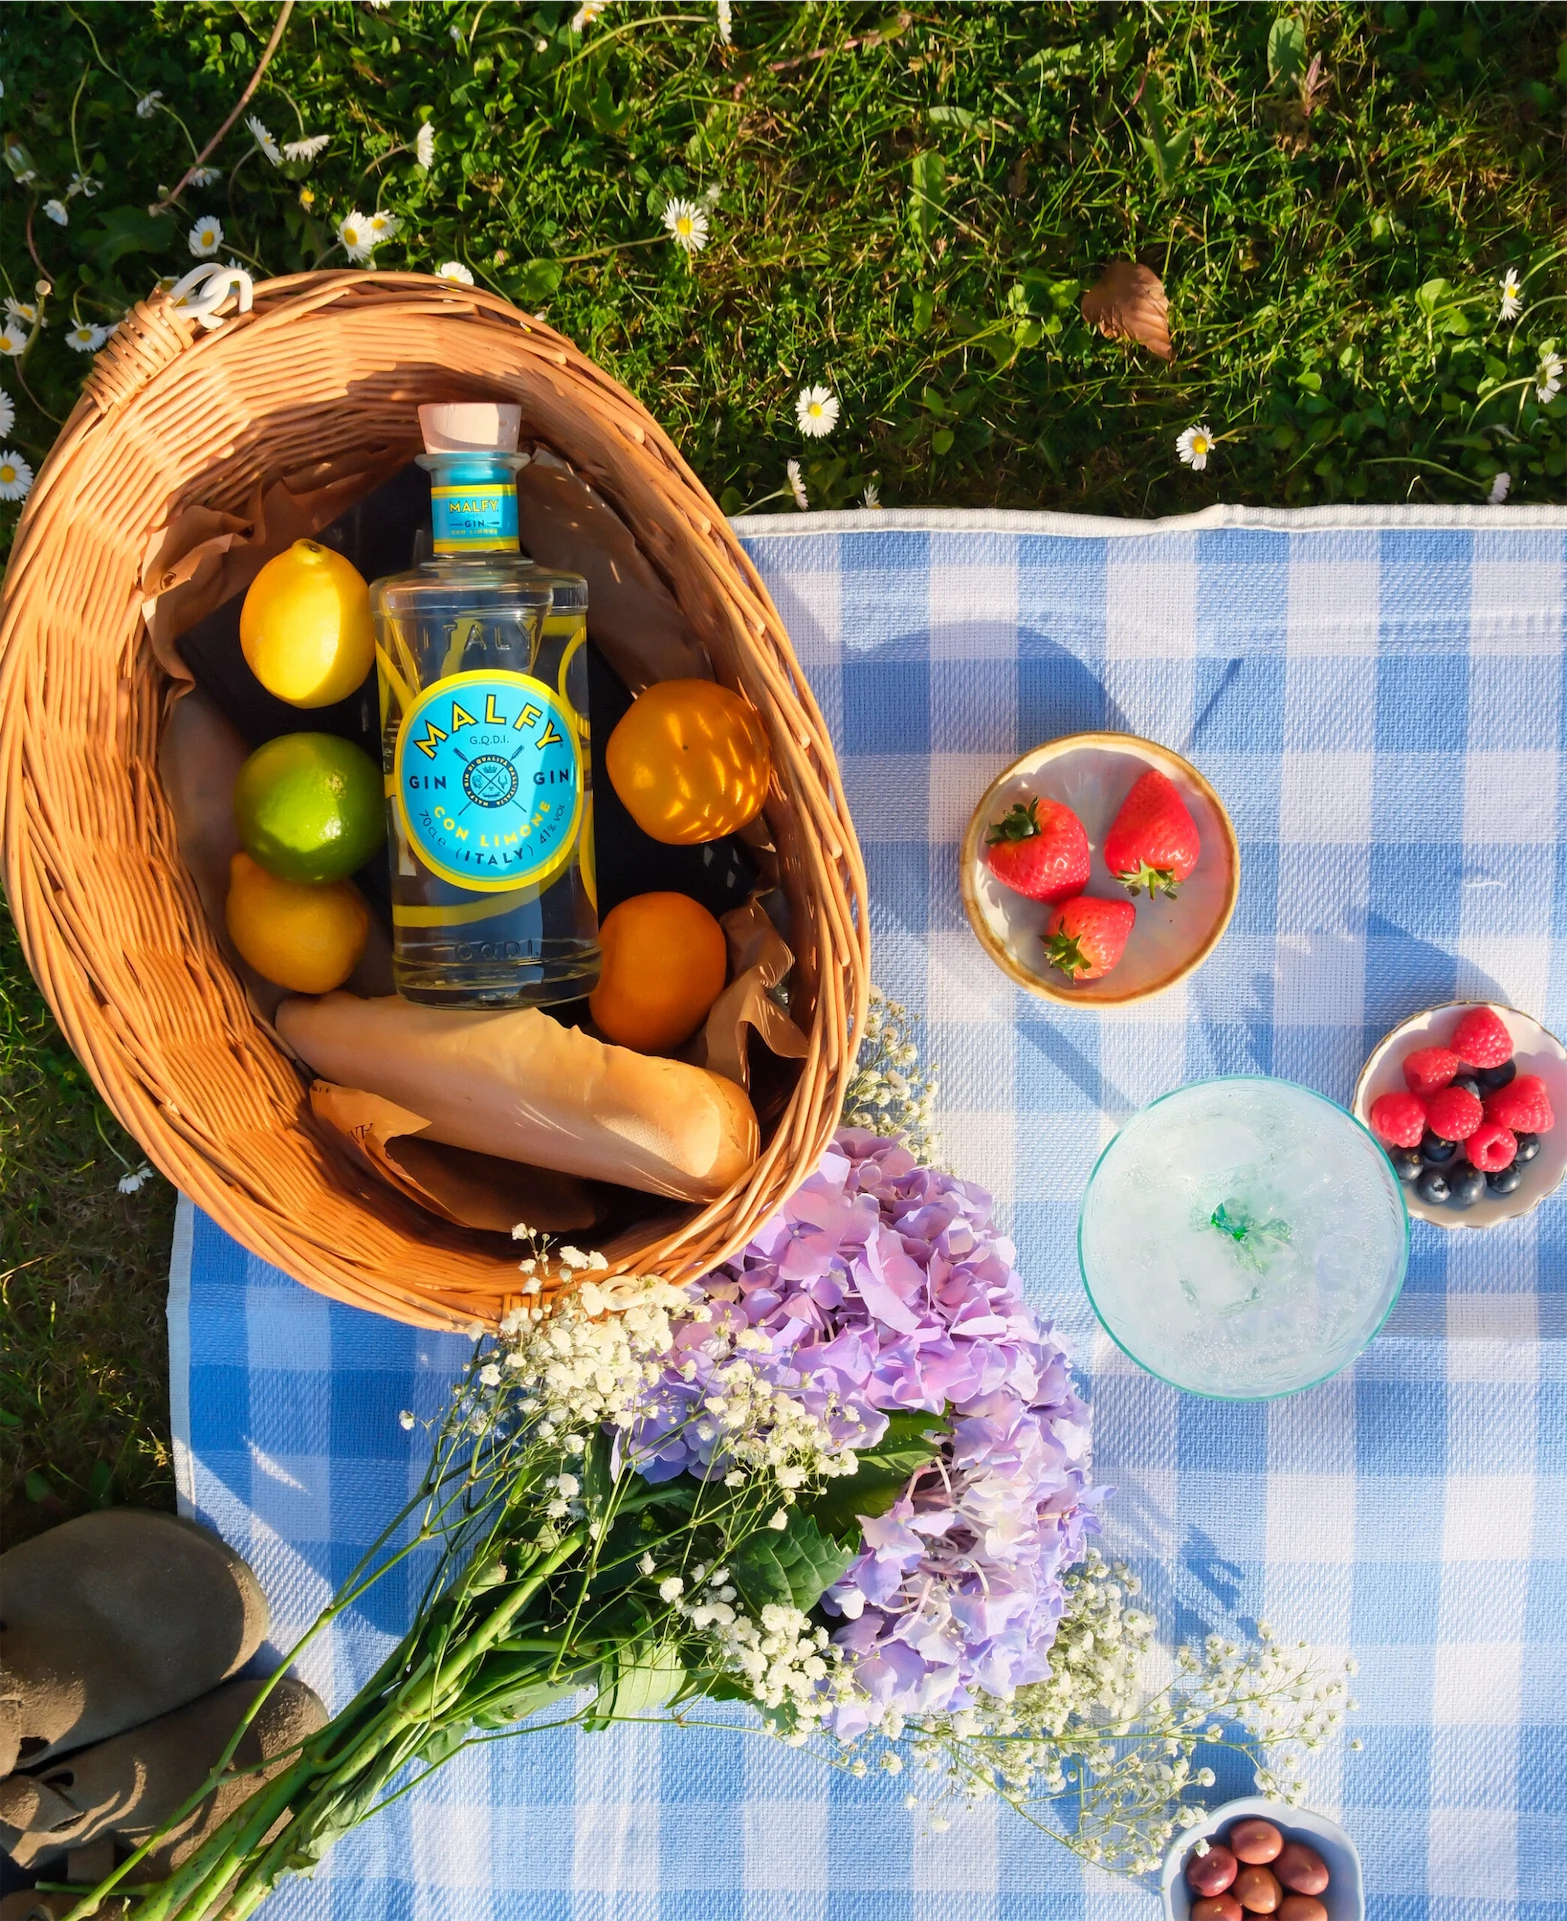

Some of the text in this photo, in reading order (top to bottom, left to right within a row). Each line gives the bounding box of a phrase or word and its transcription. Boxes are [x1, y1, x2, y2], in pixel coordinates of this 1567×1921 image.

[449, 499, 498, 513] MALFY
[464, 520, 485, 528] GIN
[422, 620, 537, 651] ITALY
[413, 694, 562, 761] MALFY
[470, 735, 509, 745] G.Q.D.I.
[409, 775, 447, 789] GIN
[533, 769, 569, 785] GIN
[434, 801, 550, 847] CON LIMONE
[455, 844, 534, 866] (ITALY)
